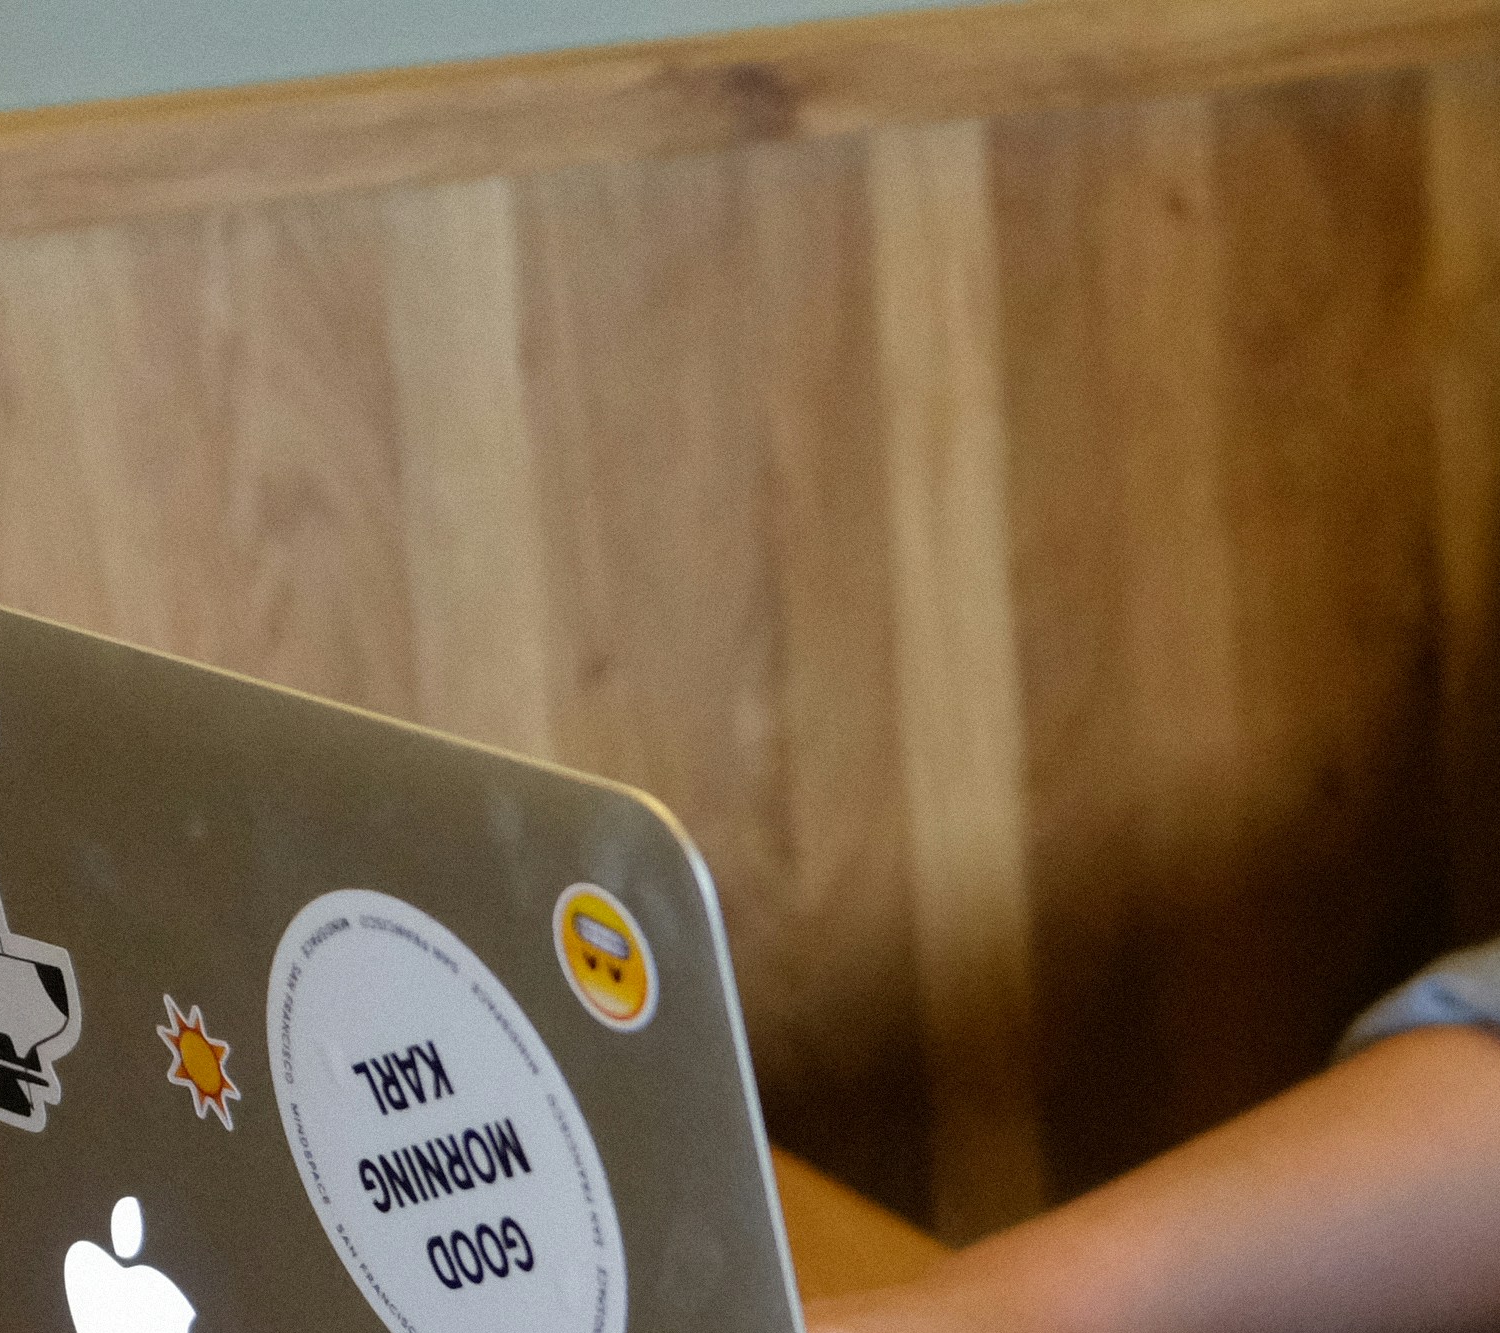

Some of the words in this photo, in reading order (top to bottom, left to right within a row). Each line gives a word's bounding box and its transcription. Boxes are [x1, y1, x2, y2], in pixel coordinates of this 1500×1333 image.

[352, 1038, 455, 1117] KARL
[291, 1103, 331, 1205] MINDSPACE
[357, 1117, 533, 1214] MORNING
[426, 1216, 535, 1290] GOOD
